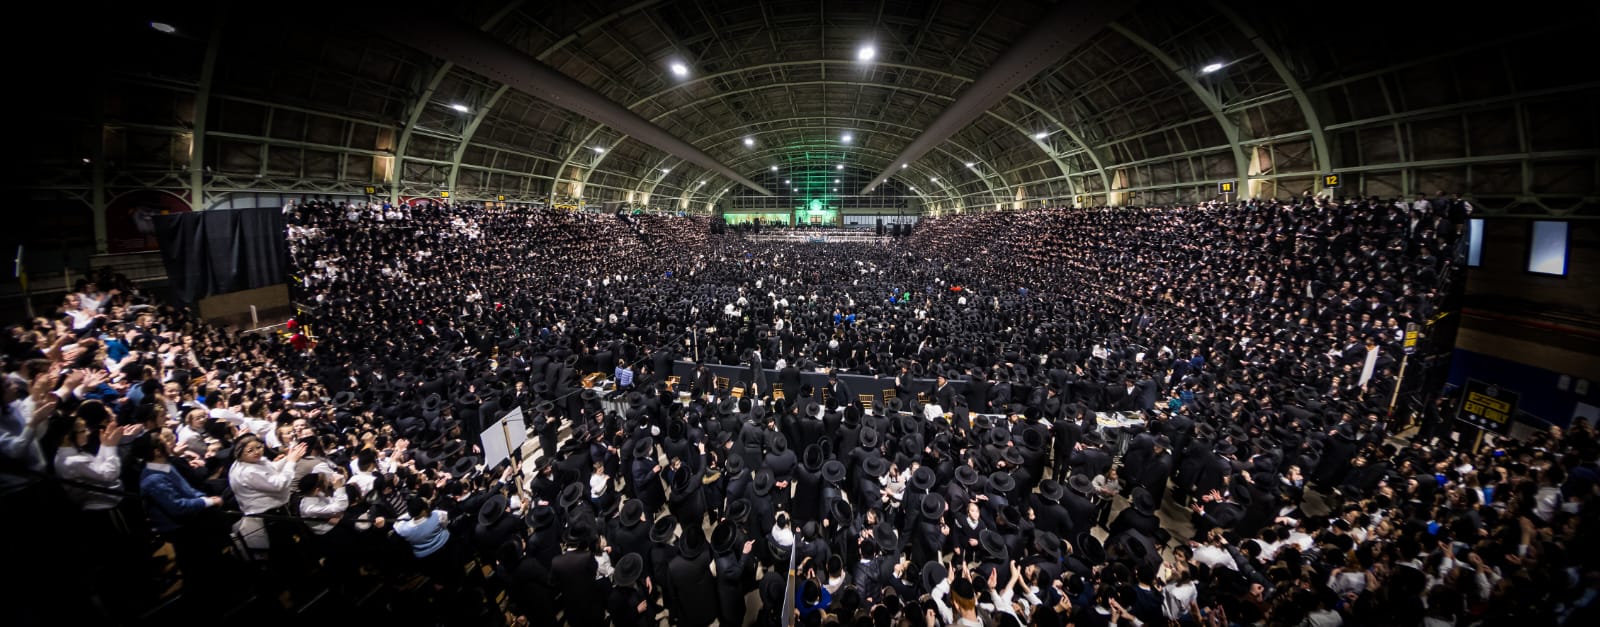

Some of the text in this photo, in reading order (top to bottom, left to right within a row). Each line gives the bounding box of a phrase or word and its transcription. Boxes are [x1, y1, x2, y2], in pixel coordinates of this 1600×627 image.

[1326, 175, 1337, 185] 12
[1222, 183, 1230, 191] 11
[1464, 401, 1484, 416] EXIT
[1484, 408, 1509, 424] ONLY
